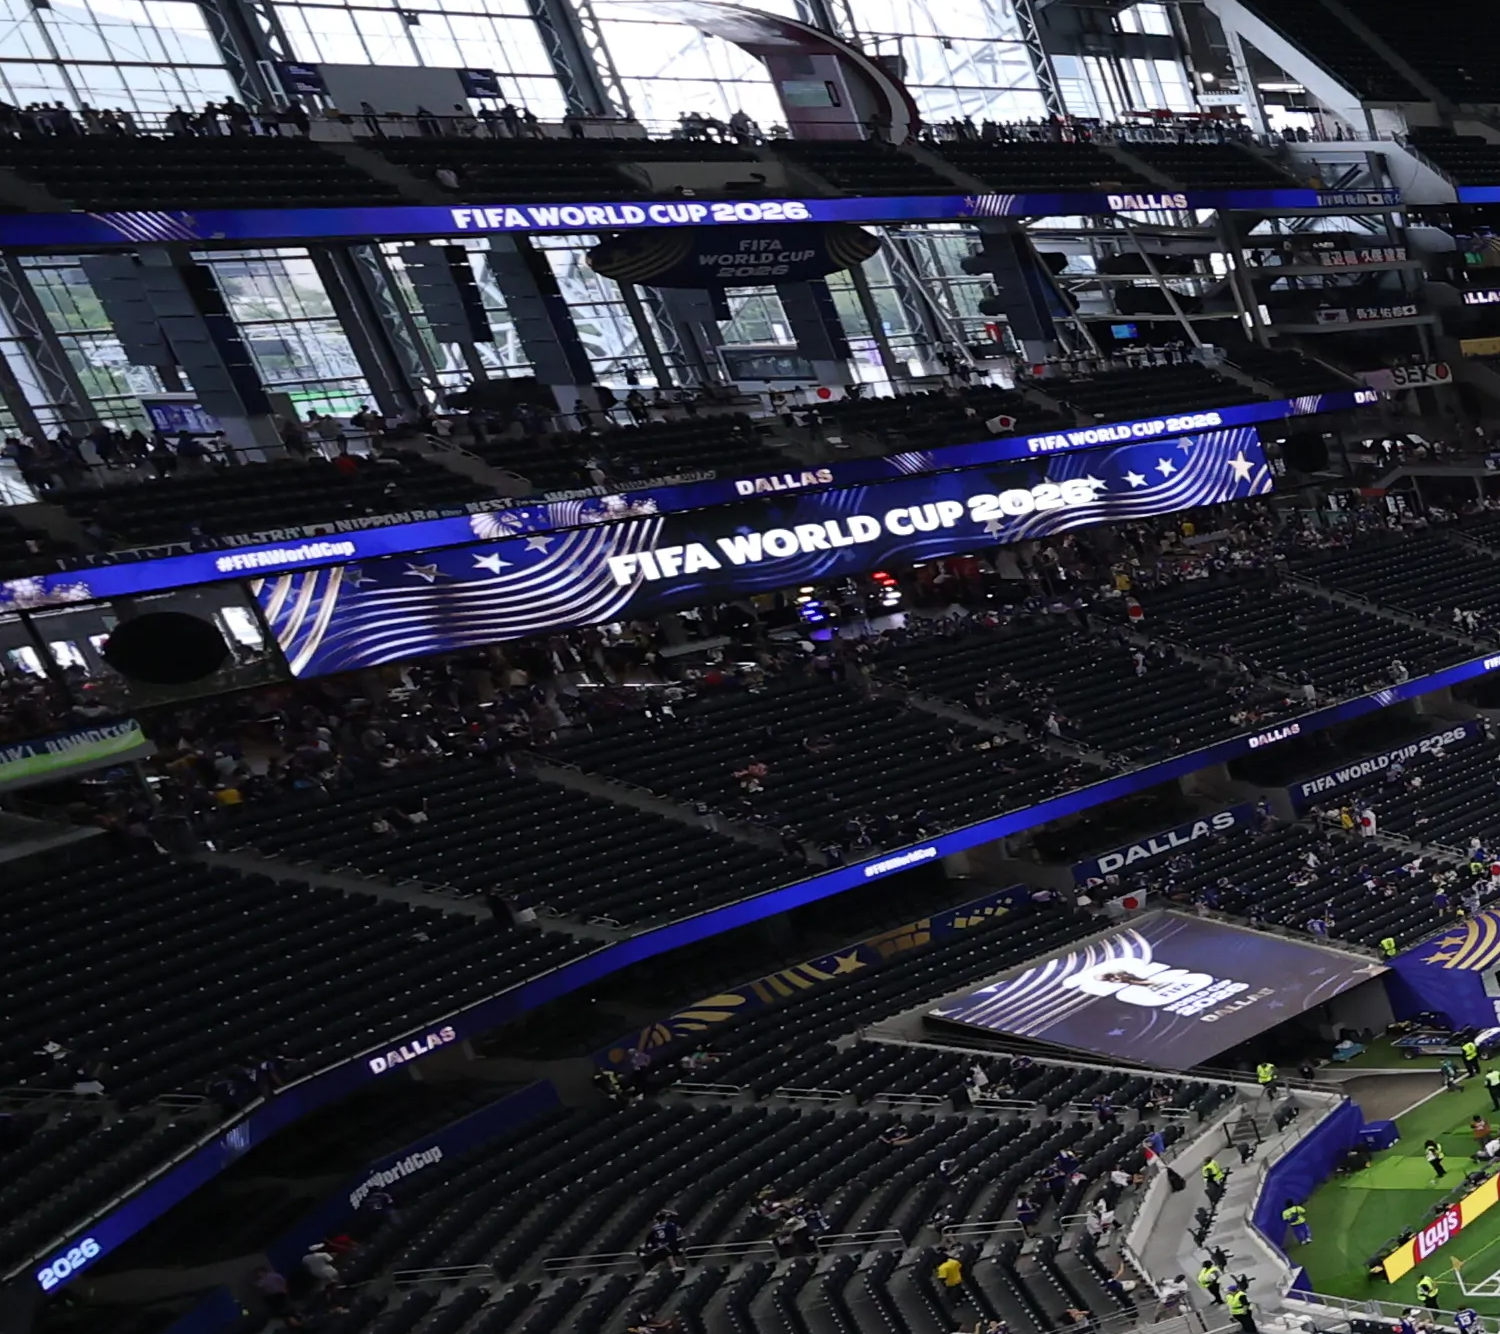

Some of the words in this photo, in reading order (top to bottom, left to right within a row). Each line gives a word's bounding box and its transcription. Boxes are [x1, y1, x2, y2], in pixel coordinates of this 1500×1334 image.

[451, 207, 530, 229] FIFA
[528, 205, 646, 227] WORLD
[649, 204, 708, 224] CUP
[711, 202, 809, 221] 2026
[1107, 194, 1188, 210] DALLAS
[699, 251, 773, 267] WORLD
[778, 250, 814, 263] CUP
[739, 239, 783, 252] FIFA
[1027, 435, 1070, 452] FIFA
[1067, 426, 1131, 446] WORLD
[1132, 420, 1165, 436] CUP
[1166, 412, 1222, 432] 2026
[735, 469, 833, 495] DALLAS
[607, 543, 721, 586] FIFA
[717, 516, 882, 566] WORLD
[885, 499, 964, 535] CUP
[967, 479, 1097, 522] 2026
[216, 540, 355, 574] #FIFAWorldCup
[1248, 723, 1301, 748] DALLAS
[1301, 776, 1337, 797] FIFA
[1335, 755, 1390, 784] WORLD
[1390, 744, 1418, 766] CUP
[1419, 727, 1467, 753] 2026
[1097, 811, 1235, 874] DALLAS
[1176, 982, 1249, 1016] 2026
[1200, 987, 1273, 1022] DALLAS
[368, 1026, 456, 1074] DALLAS
[1417, 1210, 1458, 1260] Lay's
[37, 1237, 101, 1291] 2026
